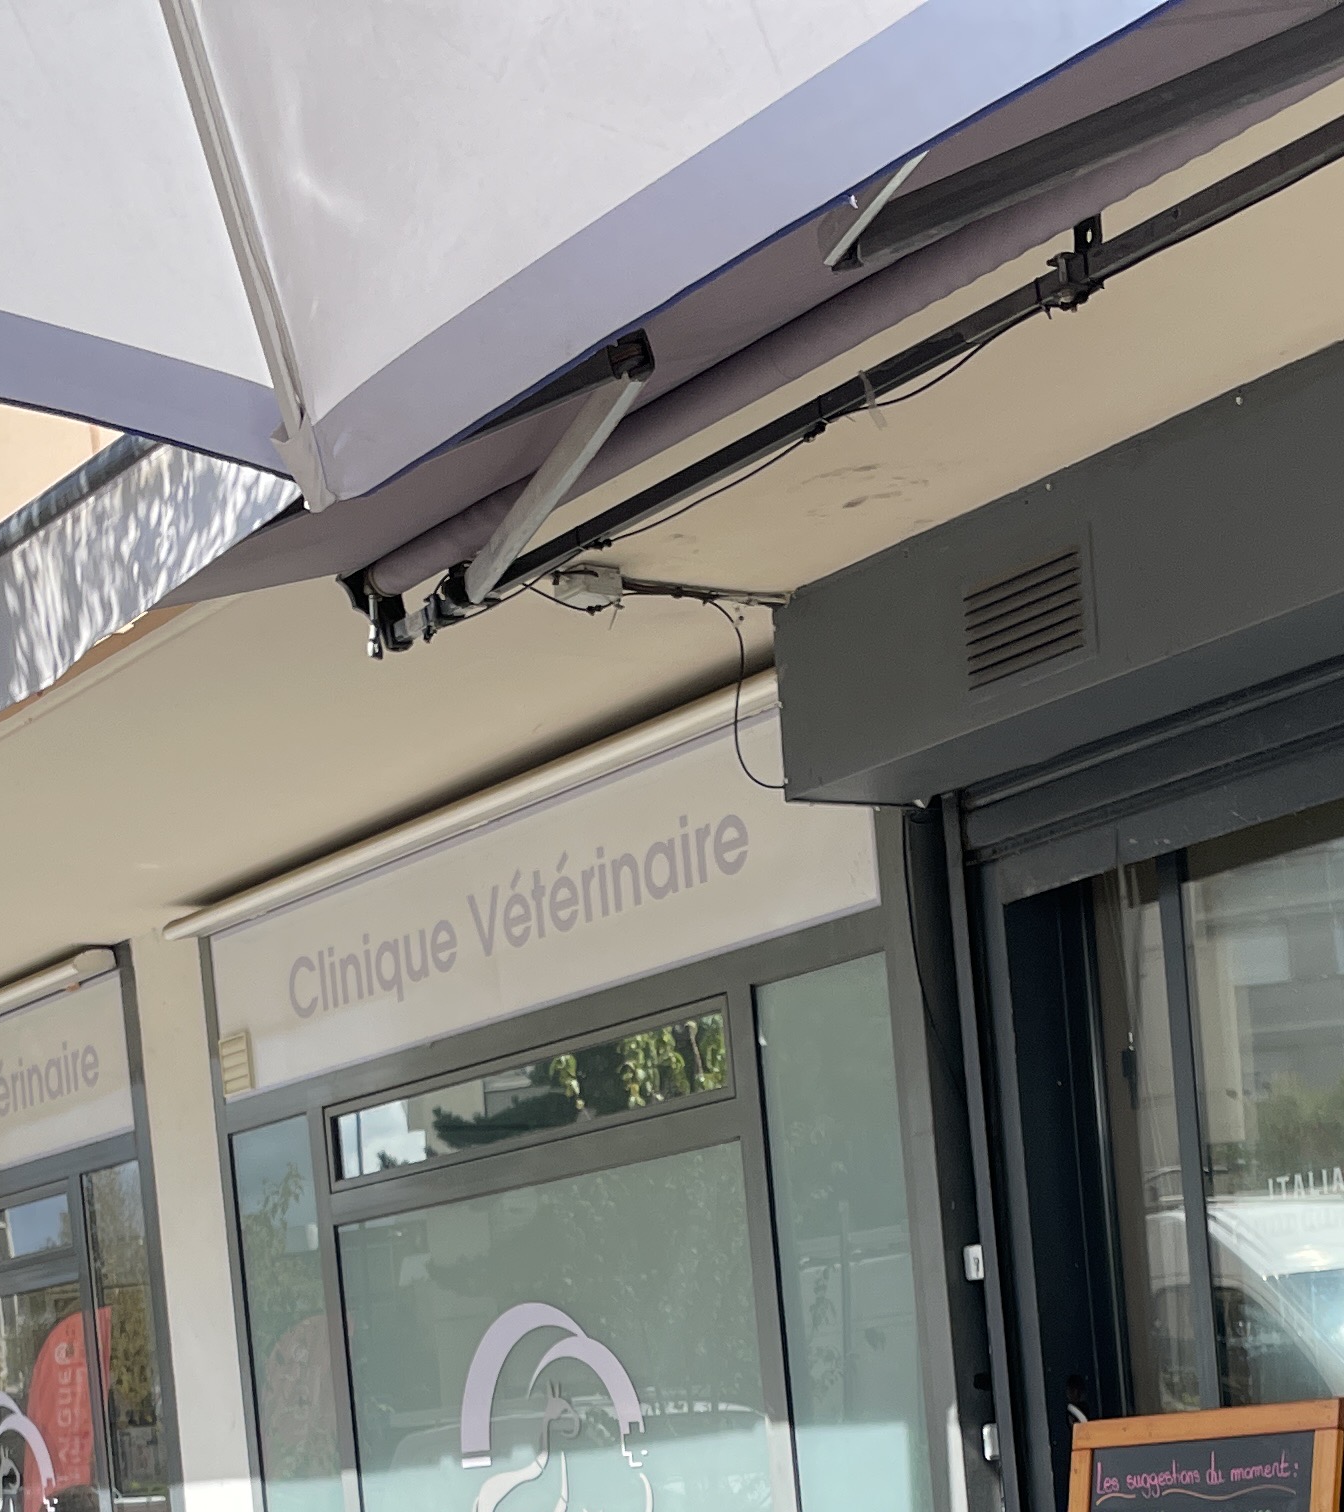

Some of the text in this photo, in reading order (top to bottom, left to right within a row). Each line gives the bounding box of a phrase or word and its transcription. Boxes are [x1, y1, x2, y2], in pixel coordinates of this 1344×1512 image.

[288, 813, 750, 1019] Clinique Vétérinaire
[1096, 1462, 1119, 1494] Les
[1126, 1459, 1200, 1498] suggestions
[1206, 1451, 1223, 1485] du
